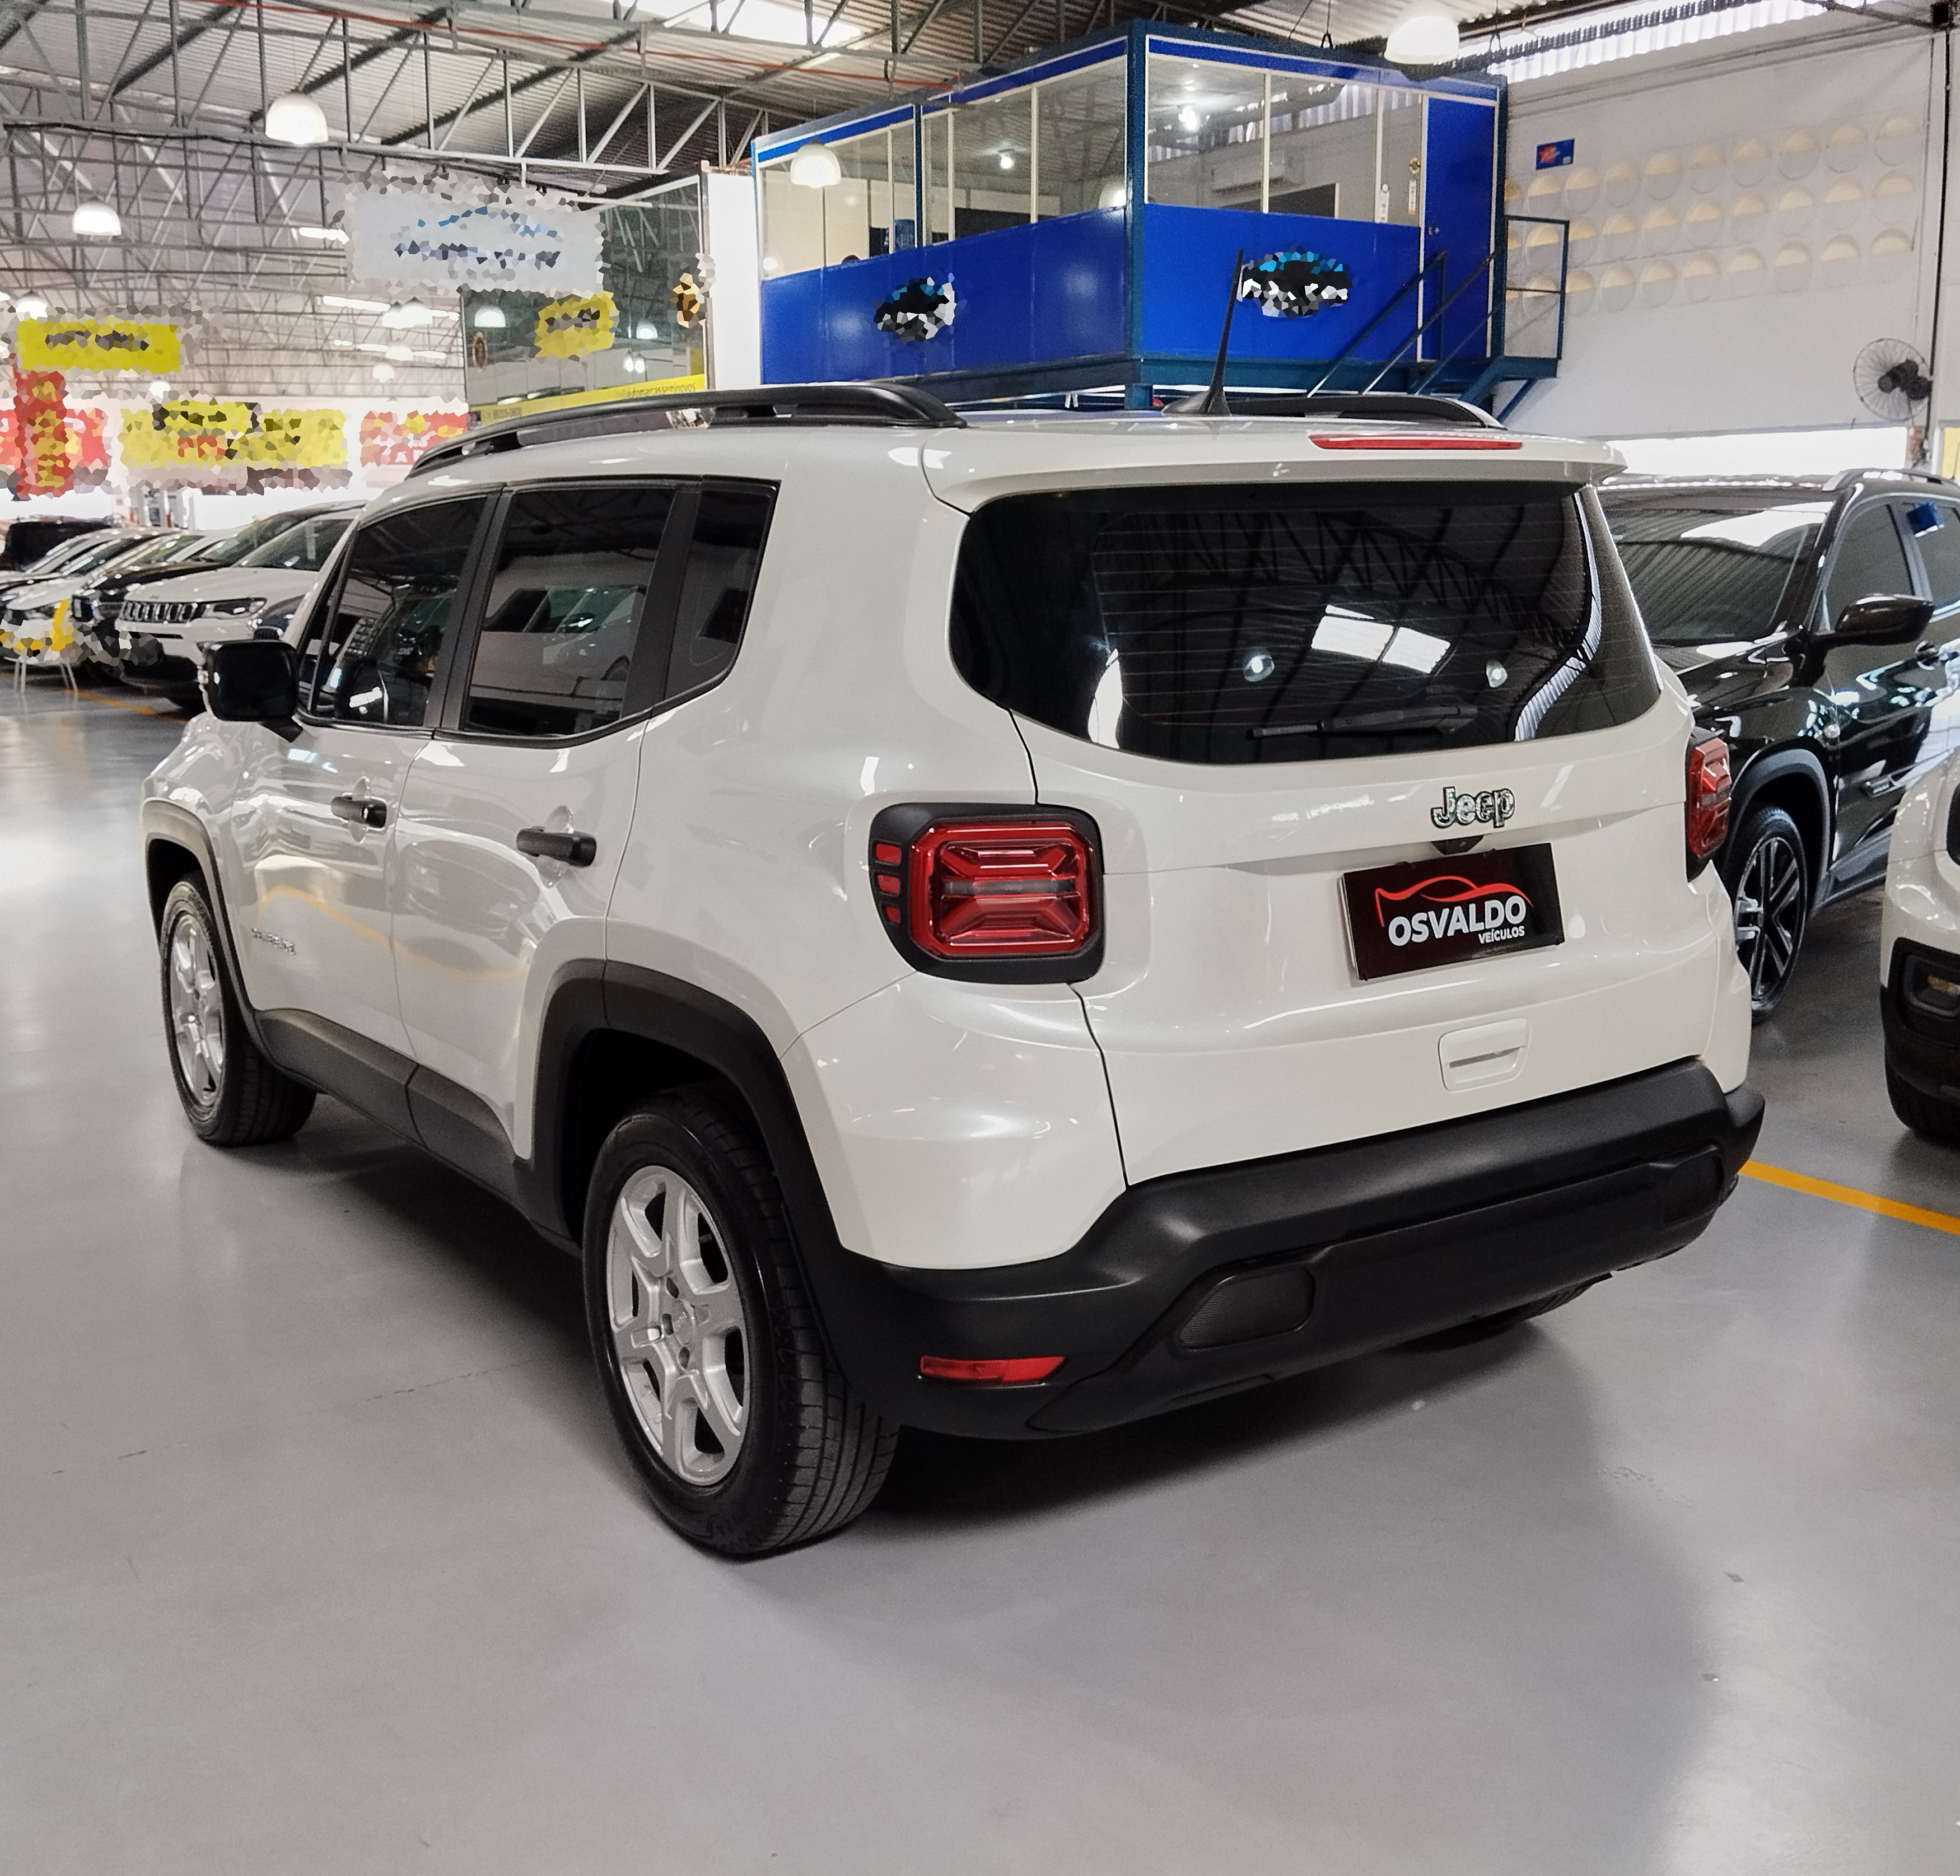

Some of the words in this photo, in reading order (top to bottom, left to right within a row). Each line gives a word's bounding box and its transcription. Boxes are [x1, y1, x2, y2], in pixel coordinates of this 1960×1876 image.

[1431, 786, 1515, 829] Jeep
[1388, 895, 1526, 946] OSVALDO
[1478, 925, 1525, 944] VEÍCULOS
